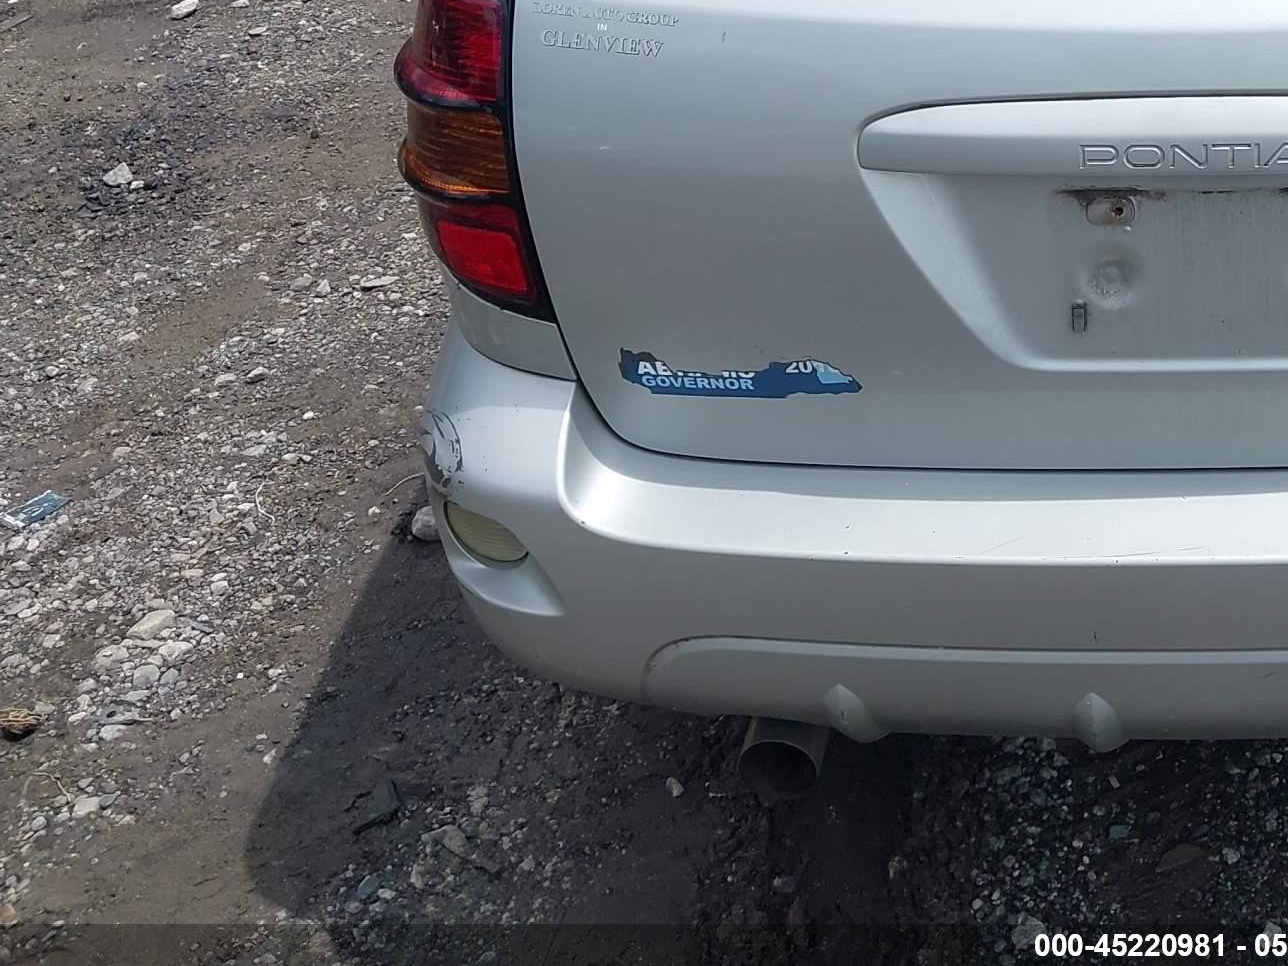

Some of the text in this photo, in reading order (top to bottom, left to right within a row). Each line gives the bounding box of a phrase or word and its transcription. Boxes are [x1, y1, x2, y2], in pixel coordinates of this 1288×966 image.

[625, 10, 679, 26] GROUP
[597, 23, 608, 31] IN
[542, 29, 664, 57] GLENVIEW
[641, 375, 755, 390] GOVERNOR
